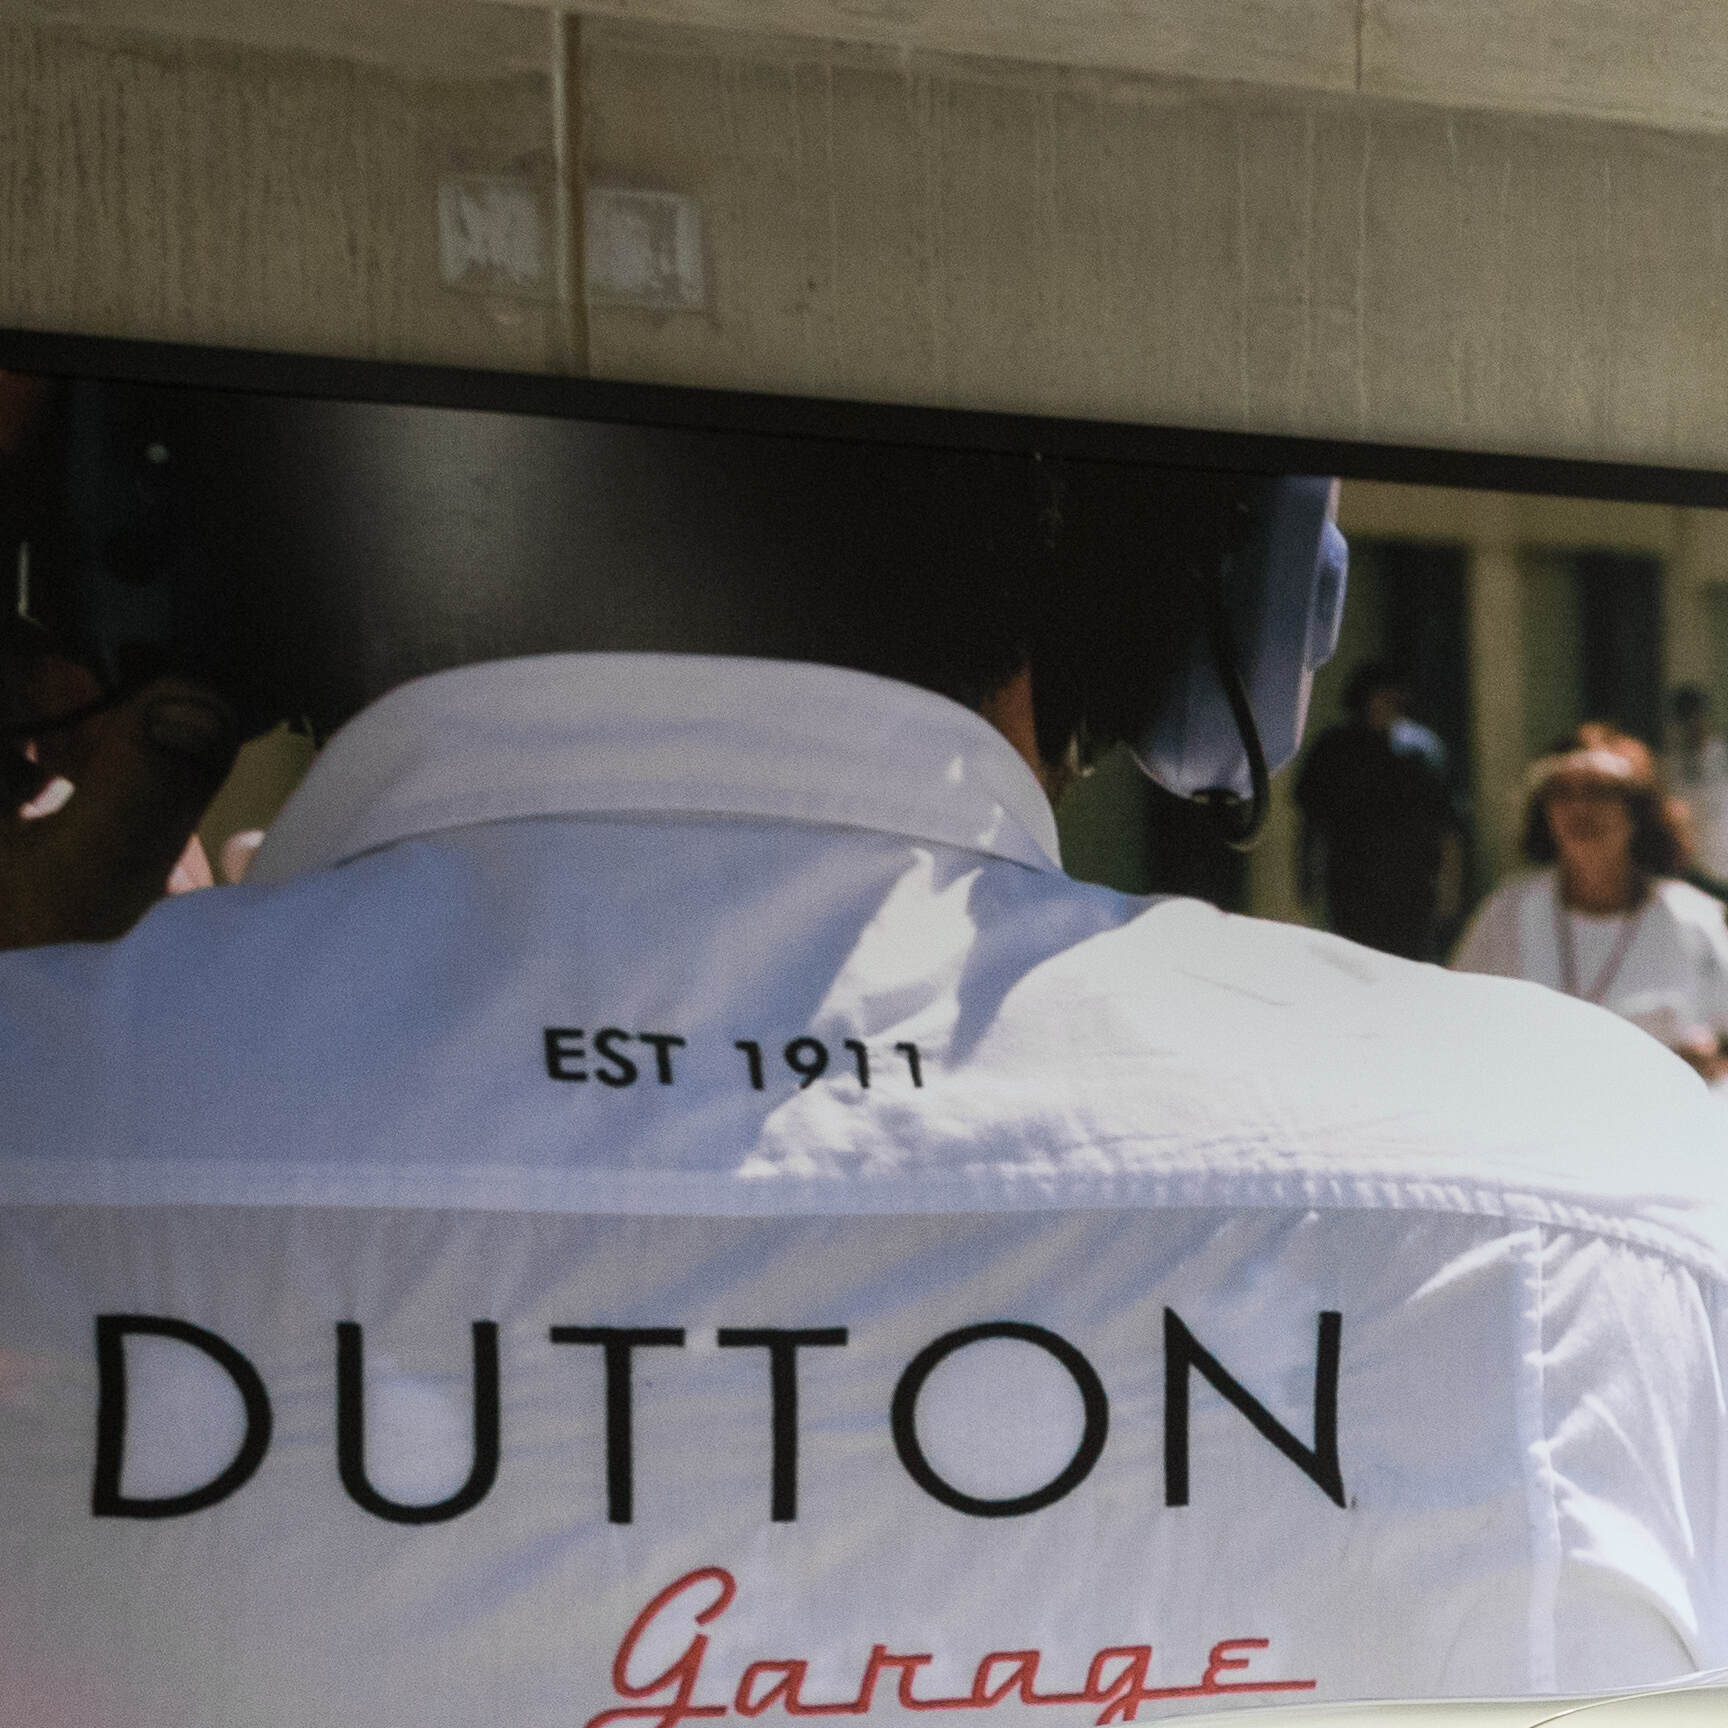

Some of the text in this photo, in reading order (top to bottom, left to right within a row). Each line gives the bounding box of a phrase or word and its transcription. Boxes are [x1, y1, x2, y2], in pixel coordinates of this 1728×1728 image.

[544, 1026, 923, 1091] EST 1911
[92, 1306, 1346, 1524] DUTTON
